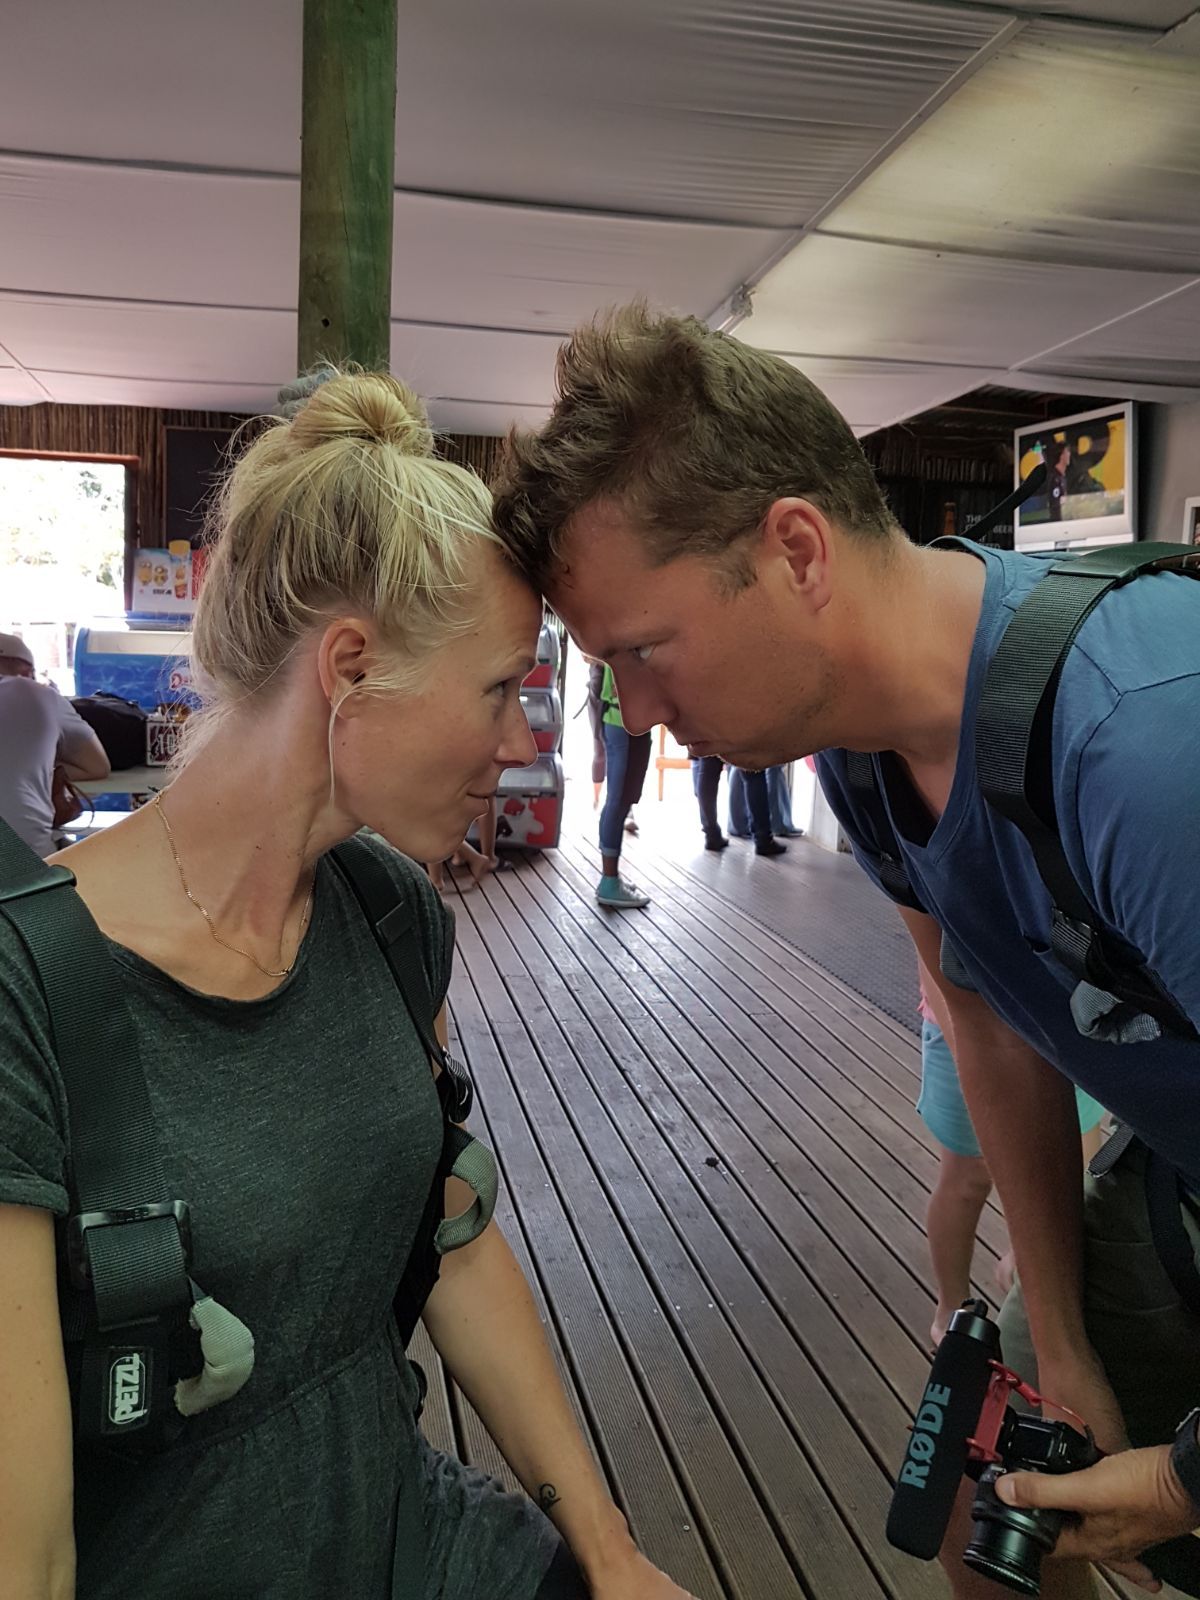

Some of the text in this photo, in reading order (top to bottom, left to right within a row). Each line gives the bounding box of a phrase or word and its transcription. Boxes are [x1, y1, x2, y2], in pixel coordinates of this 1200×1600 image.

[993, 524, 1014, 535] BEER
[114, 1352, 148, 1422] PETZL
[900, 1382, 952, 1489] RØDE
